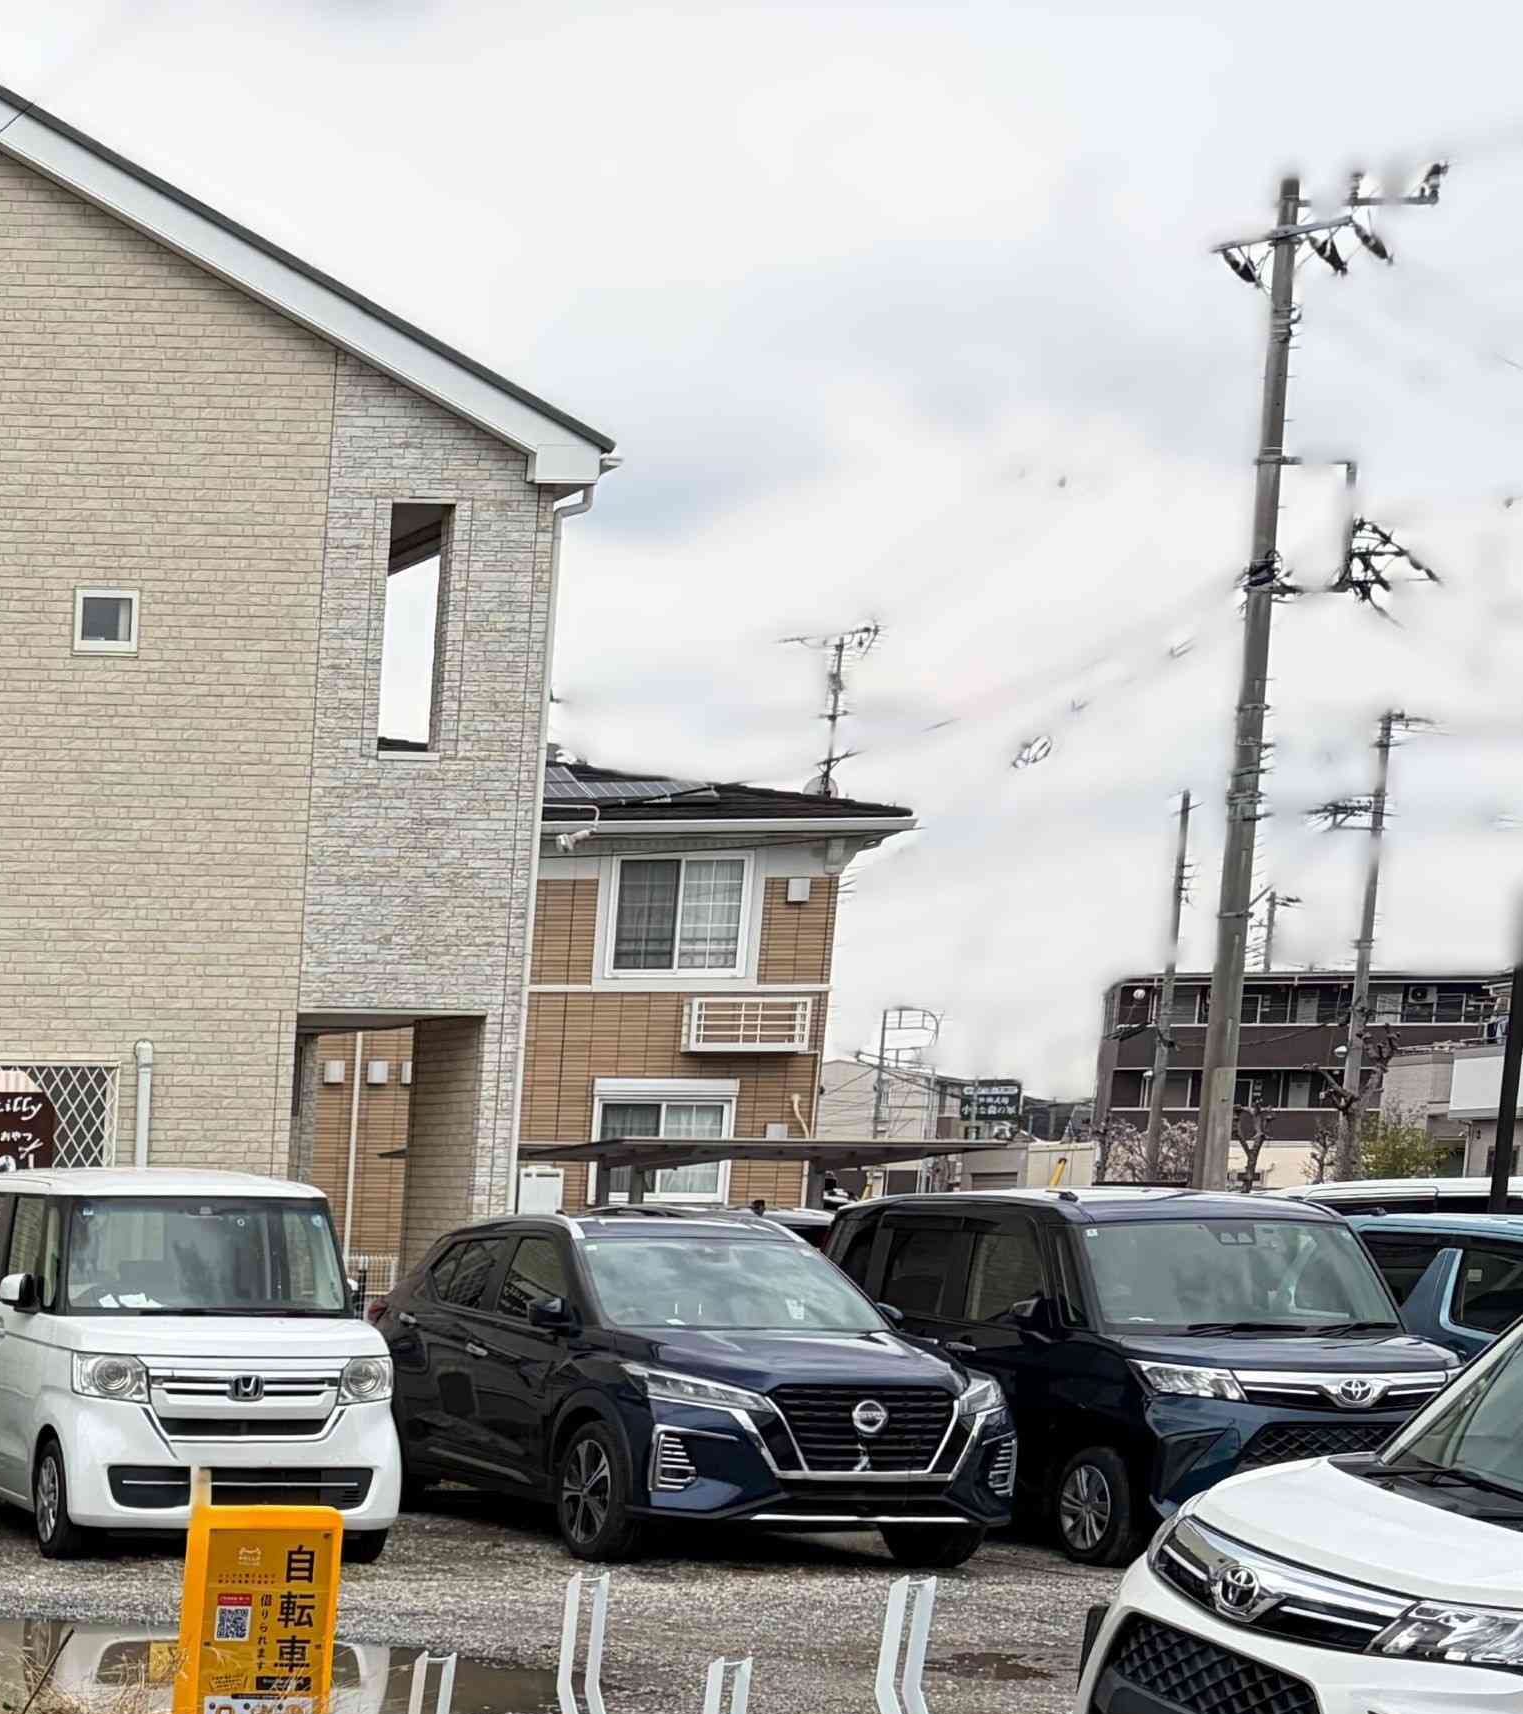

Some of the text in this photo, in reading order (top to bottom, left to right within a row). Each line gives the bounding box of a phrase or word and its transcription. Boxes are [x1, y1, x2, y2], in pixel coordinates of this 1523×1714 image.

[256, 1593, 274, 1672] 借りられます
[274, 1544, 316, 1673] 自転車
